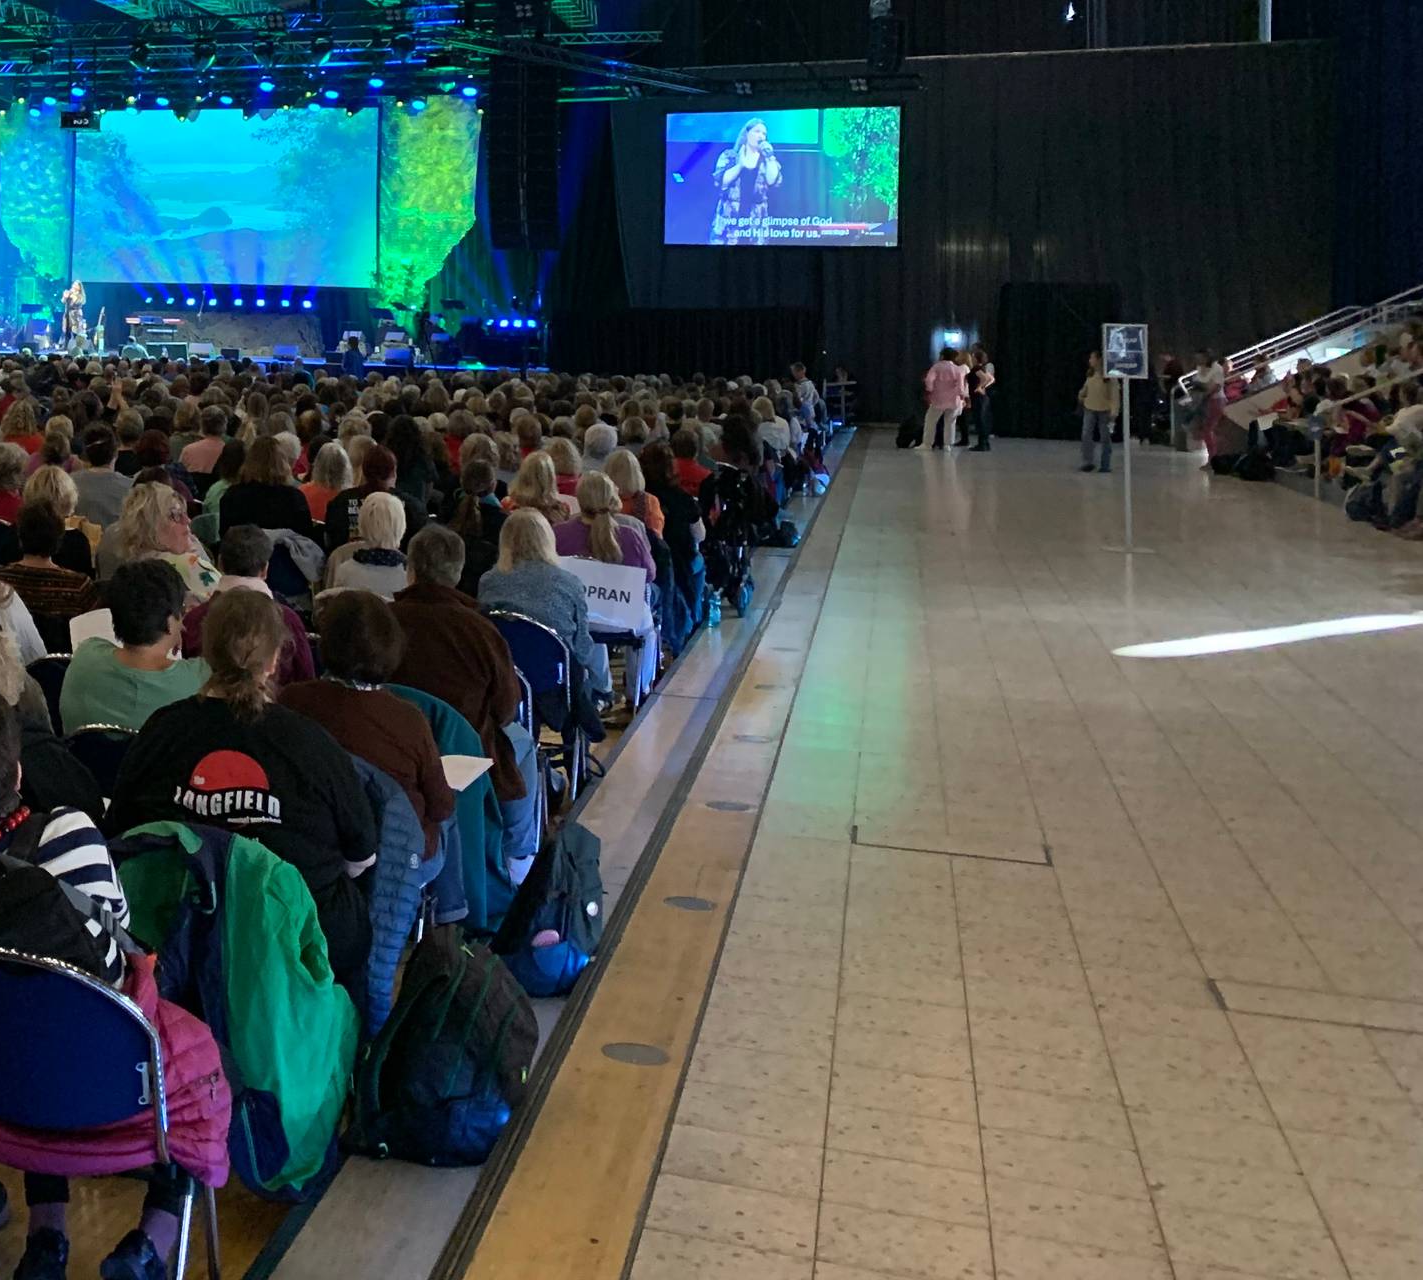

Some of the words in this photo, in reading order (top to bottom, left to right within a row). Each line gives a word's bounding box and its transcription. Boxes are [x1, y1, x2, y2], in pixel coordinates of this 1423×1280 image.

[738, 217, 754, 227] get
[763, 216, 799, 228] glimpse
[800, 216, 811, 225] of
[812, 216, 833, 225] God
[735, 228, 751, 237] and
[753, 228, 769, 238] His
[770, 228, 789, 238] love
[791, 228, 805, 237] for
[806, 229, 821, 239] us.
[583, 585, 631, 604] PRAN
[173, 785, 281, 818] LONGFIELD
